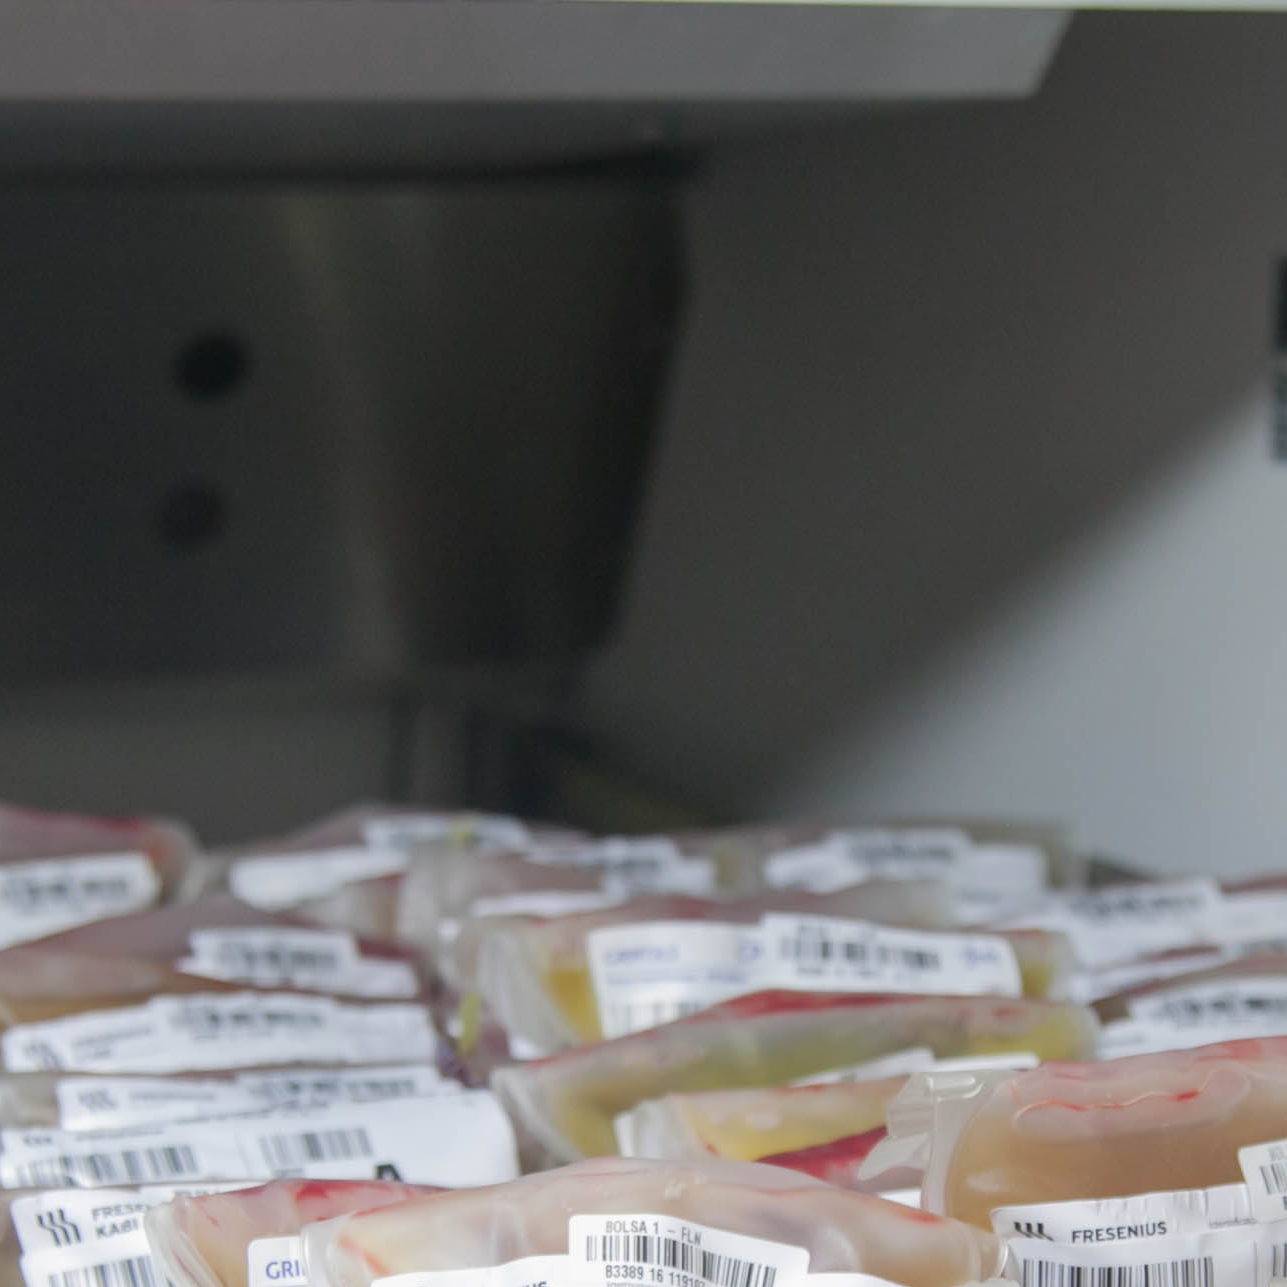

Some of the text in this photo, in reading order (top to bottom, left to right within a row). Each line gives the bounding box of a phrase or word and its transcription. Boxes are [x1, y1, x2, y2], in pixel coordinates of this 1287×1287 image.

[606, 1220, 648, 1234] BOLSA
[652, 1222, 659, 1235] 1
[682, 1226, 703, 1245] FLN
[1071, 1221, 1168, 1244] FRESENIUS
[606, 1265, 645, 1280] B3389
[649, 1268, 664, 1283] 16
